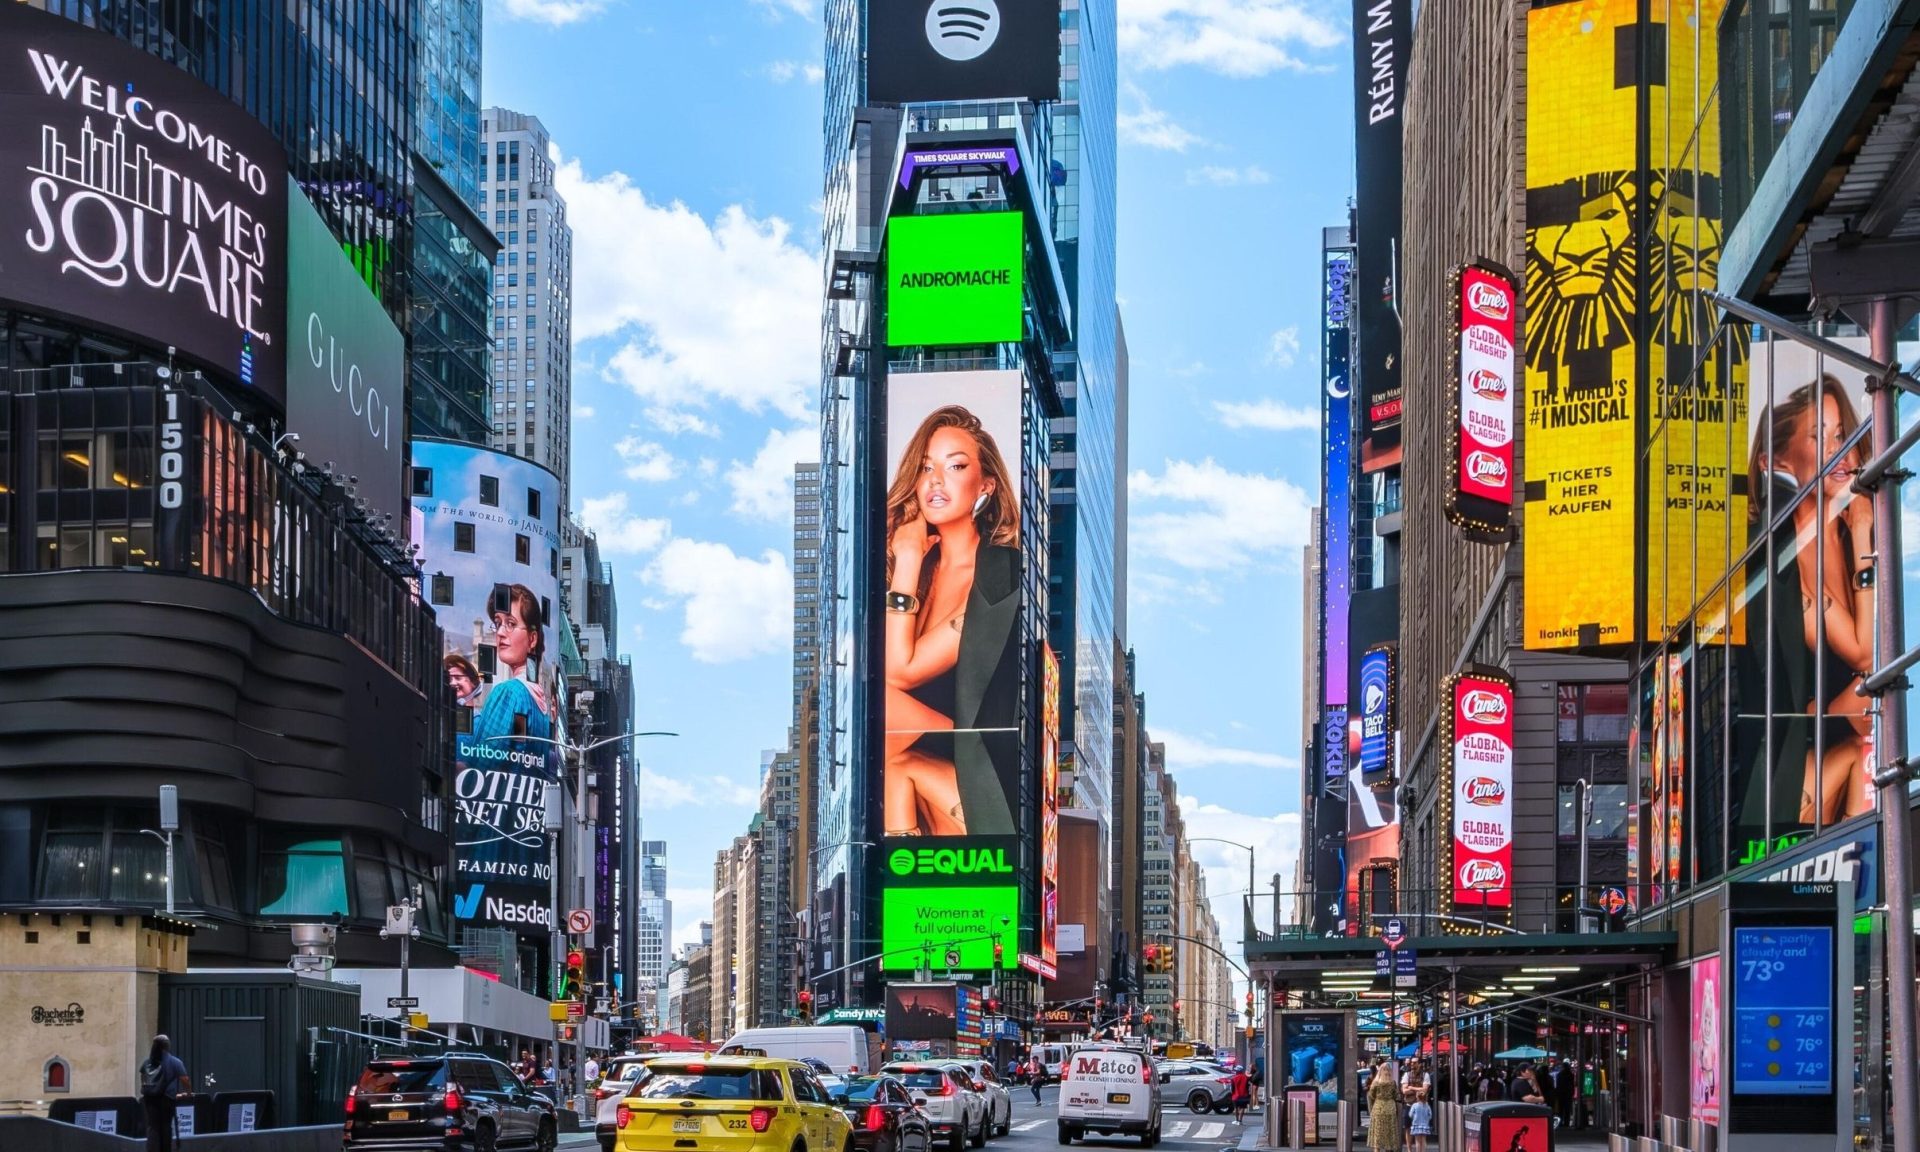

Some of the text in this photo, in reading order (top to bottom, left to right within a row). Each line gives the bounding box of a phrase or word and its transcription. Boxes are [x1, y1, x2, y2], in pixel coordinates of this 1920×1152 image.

[1369, 38, 1394, 125] RÉMY
[27, 48, 266, 195] WELCOME TO
[914, 151, 1005, 163] TIMES SQUARE SKYWALK
[152, 162, 267, 268] TIMES
[900, 269, 1011, 288] ANDROMACHE
[1469, 282, 1507, 309] Cane's
[1470, 327, 1507, 349] GLOBAL
[1469, 339, 1507, 360] FLAGSHIP
[307, 312, 390, 451] GUCCI
[1469, 368, 1507, 392] Cane's
[1532, 388, 1558, 407] THE
[1468, 410, 1506, 432] GLOBAL
[1529, 398, 1629, 429] #1 MUSICAL
[1468, 424, 1506, 443] FLAGSHIP
[159, 394, 183, 508] 1500
[1467, 451, 1506, 476] Cane's
[1548, 467, 1612, 483] TICKETS
[1562, 485, 1597, 497] HIER
[1549, 500, 1611, 516] KAUFEN
[442, 507, 463, 516] THE
[469, 511, 503, 523] WORLD
[508, 518, 519, 527] OF
[520, 520, 543, 535] JANE
[1463, 690, 1504, 715] Cane's
[1364, 715, 1383, 727] TACO
[1365, 725, 1383, 738] BELL
[1463, 736, 1504, 752] GLOBAL
[460, 742, 545, 768] britbox original
[1463, 749, 1505, 763] FLAGSHIP
[1462, 777, 1505, 800] Cane's
[1462, 820, 1504, 835] GLOBAL
[1462, 833, 1505, 847] FLAGSHIP
[917, 849, 1013, 874] EQUAL
[1461, 860, 1503, 884] Cane's
[1793, 885, 1833, 893] LinkNYC
[486, 897, 551, 930] Nasdaq
[917, 907, 985, 919] Women at
[914, 923, 935, 934] full
[1741, 934, 1815, 947] It's partly
[1741, 947, 1807, 960] cloudy and
[1742, 960, 1785, 981] 73°
[834, 1009, 863, 1021] Candy
[1795, 1015, 1824, 1028] 74°
[1795, 1038, 1823, 1051] 76°
[1795, 1062, 1824, 1076] 74°
[729, 1120, 747, 1128] 232
